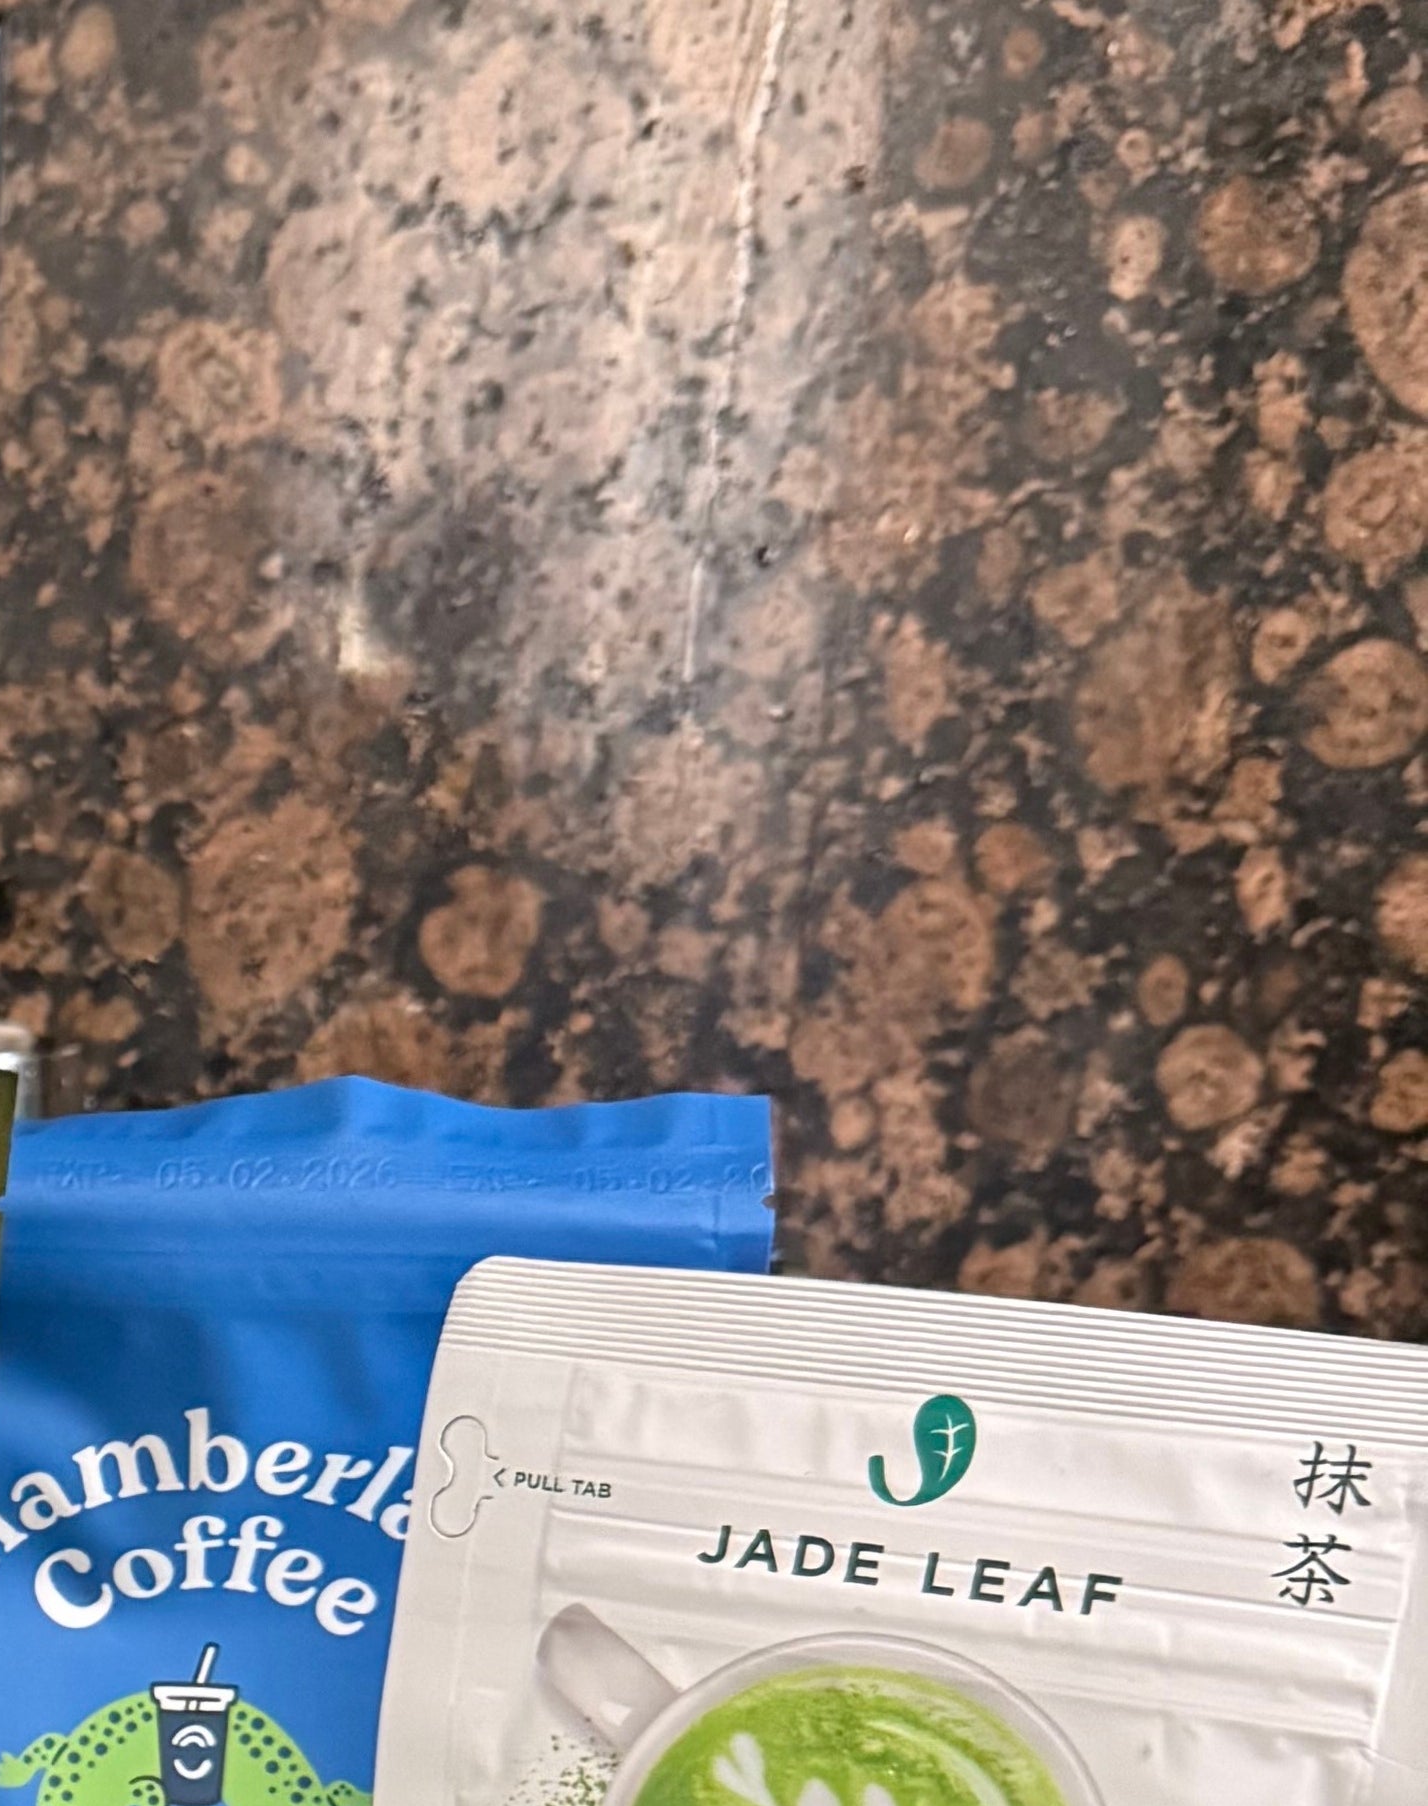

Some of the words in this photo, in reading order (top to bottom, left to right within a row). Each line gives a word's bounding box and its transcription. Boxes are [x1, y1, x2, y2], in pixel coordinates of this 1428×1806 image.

[514, 1471, 565, 1493] PULL
[571, 1479, 611, 1498] TAB
[1270, 1440, 1373, 1606] 抹茶
[34, 1514, 379, 1637] Coffee
[697, 1524, 884, 1587] JADE
[921, 1550, 1124, 1617] LEAF
